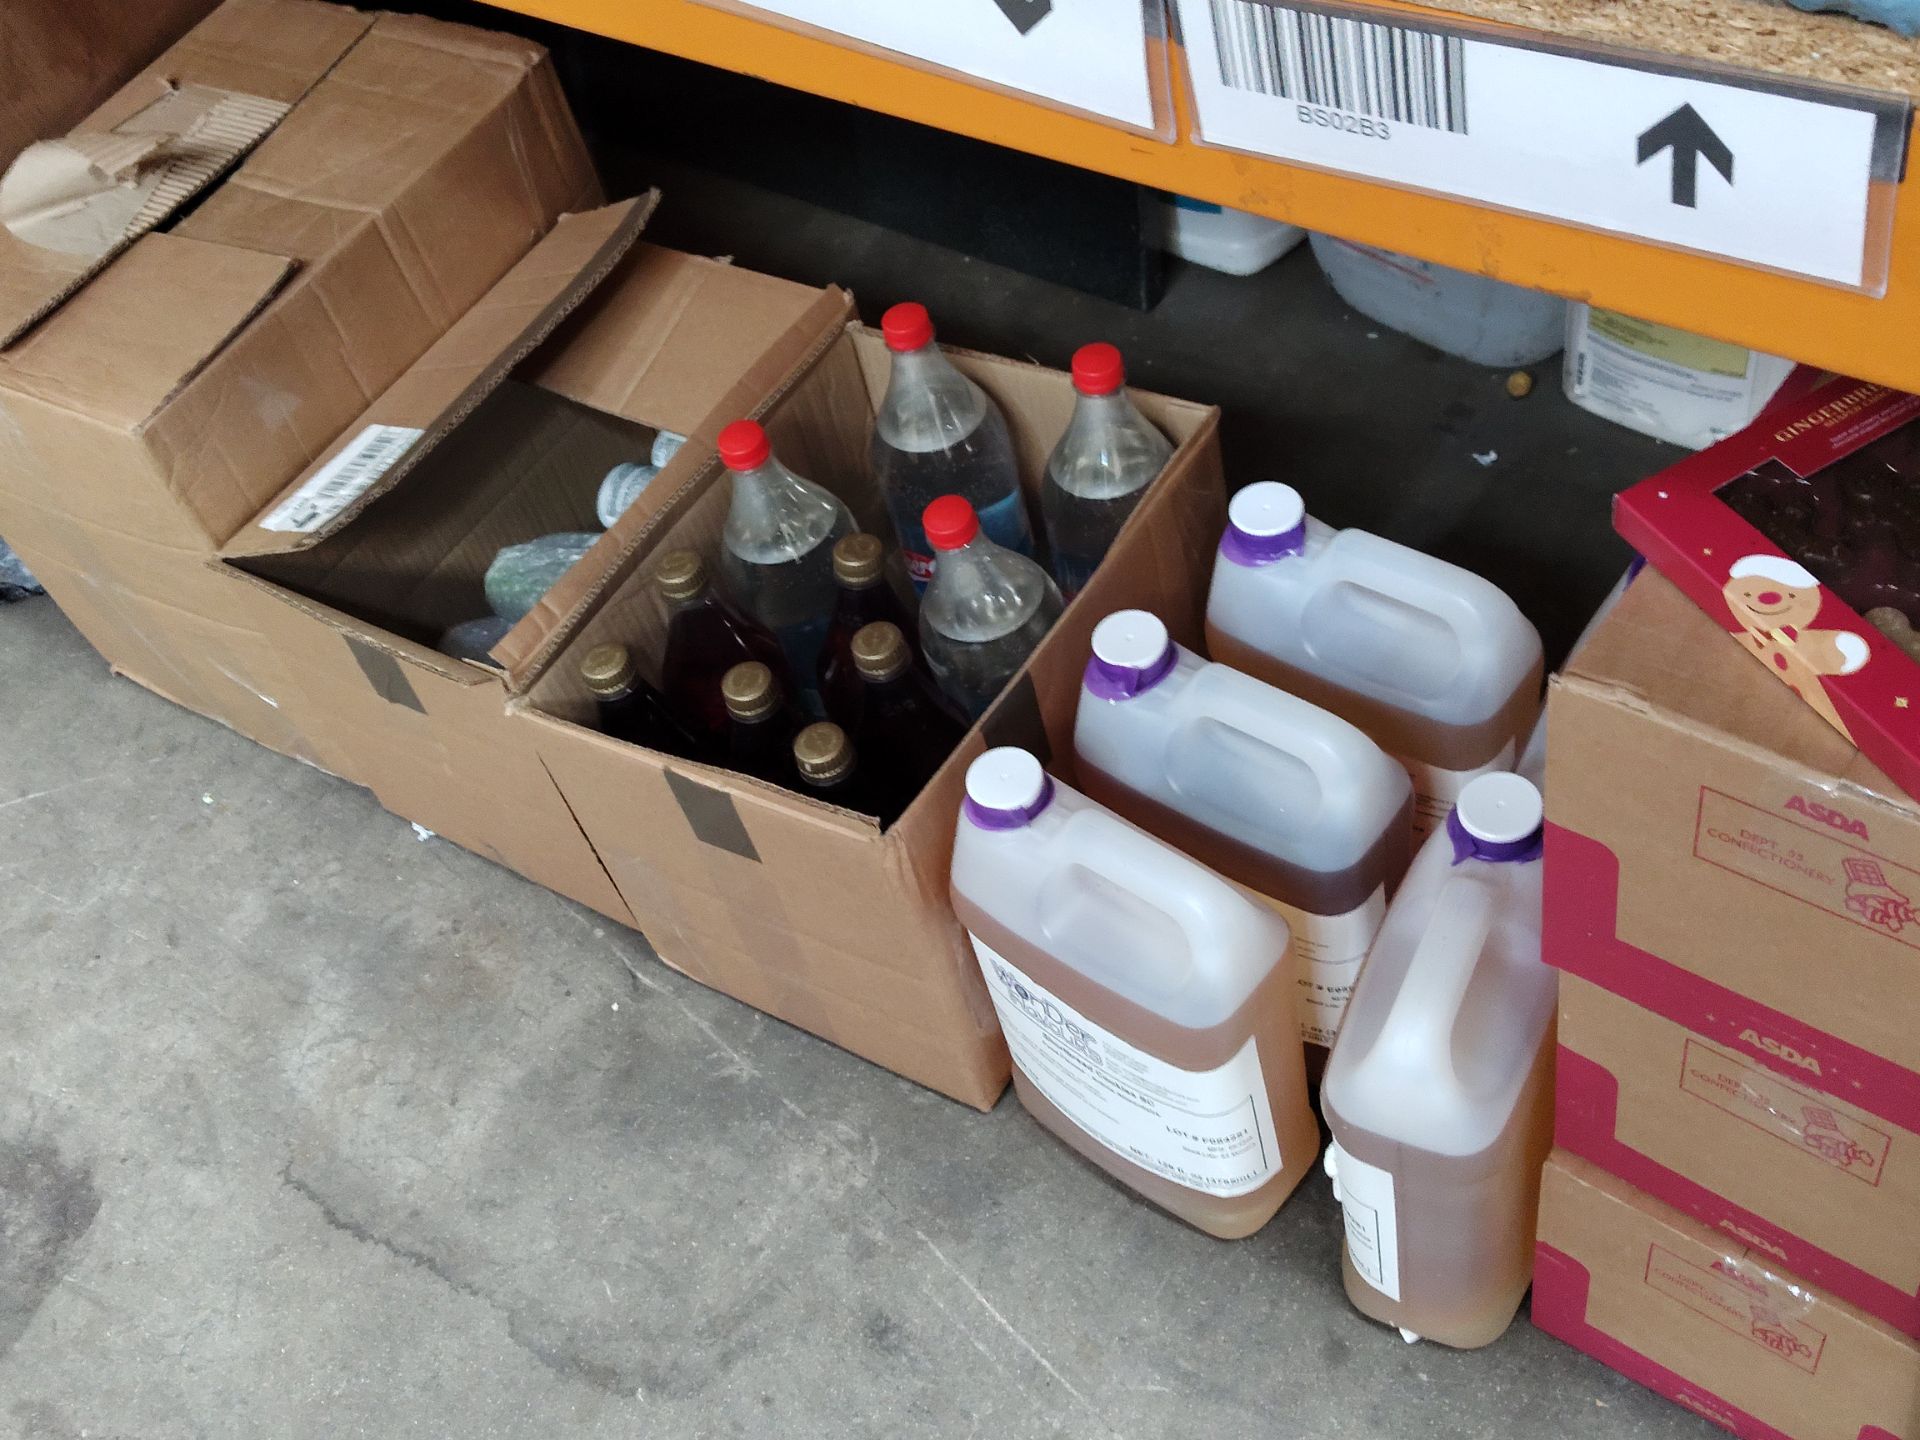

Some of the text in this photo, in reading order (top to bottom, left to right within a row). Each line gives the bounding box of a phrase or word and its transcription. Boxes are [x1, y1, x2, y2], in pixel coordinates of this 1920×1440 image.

[1296, 105, 1391, 140] BS02B3
[1784, 795, 1869, 842] ASDA
[1707, 827, 1835, 885] CONFECTIONERY
[1739, 1028, 1822, 1077] ASDA
[1720, 1219, 1787, 1261] ASDA
[1676, 1394, 1737, 1430] ASDA
